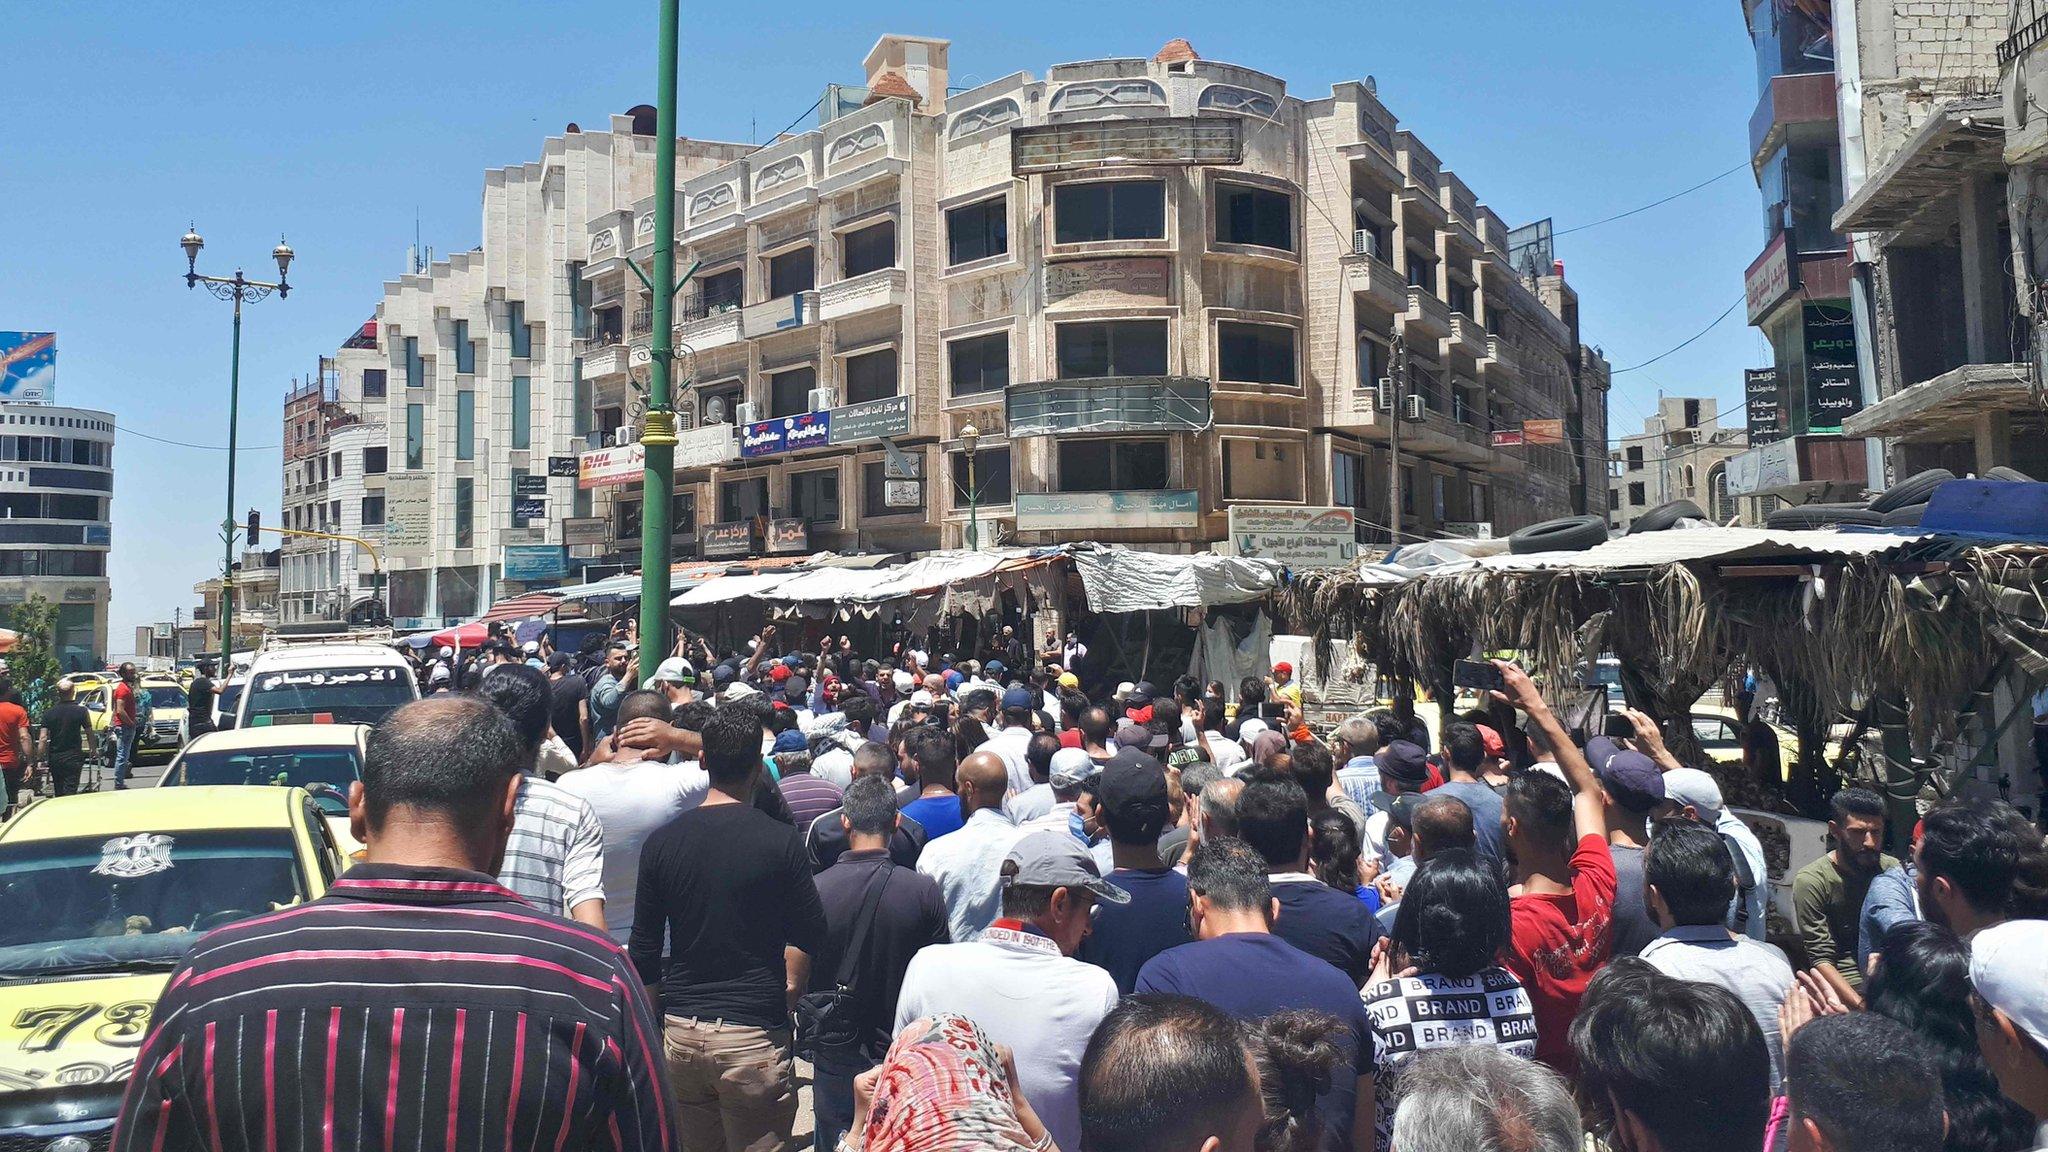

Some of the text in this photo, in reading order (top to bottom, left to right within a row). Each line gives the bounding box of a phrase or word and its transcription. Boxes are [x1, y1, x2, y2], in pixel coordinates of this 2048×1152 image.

[1820, 378, 1850, 389] الستائر
[1751, 400, 1777, 410] سجاد
[1818, 397, 1853, 409] والموبيليا
[584, 453, 611, 469] DHL
[730, 524, 748, 539] مركز
[778, 523, 805, 542] عمر
[262, 672, 325, 691] وسام
[1011, 931, 1020, 943] IN
[1411, 976, 1475, 991] BRAND
[1417, 999, 1482, 1016] BRAND
[1424, 1024, 1488, 1042] BRAND
